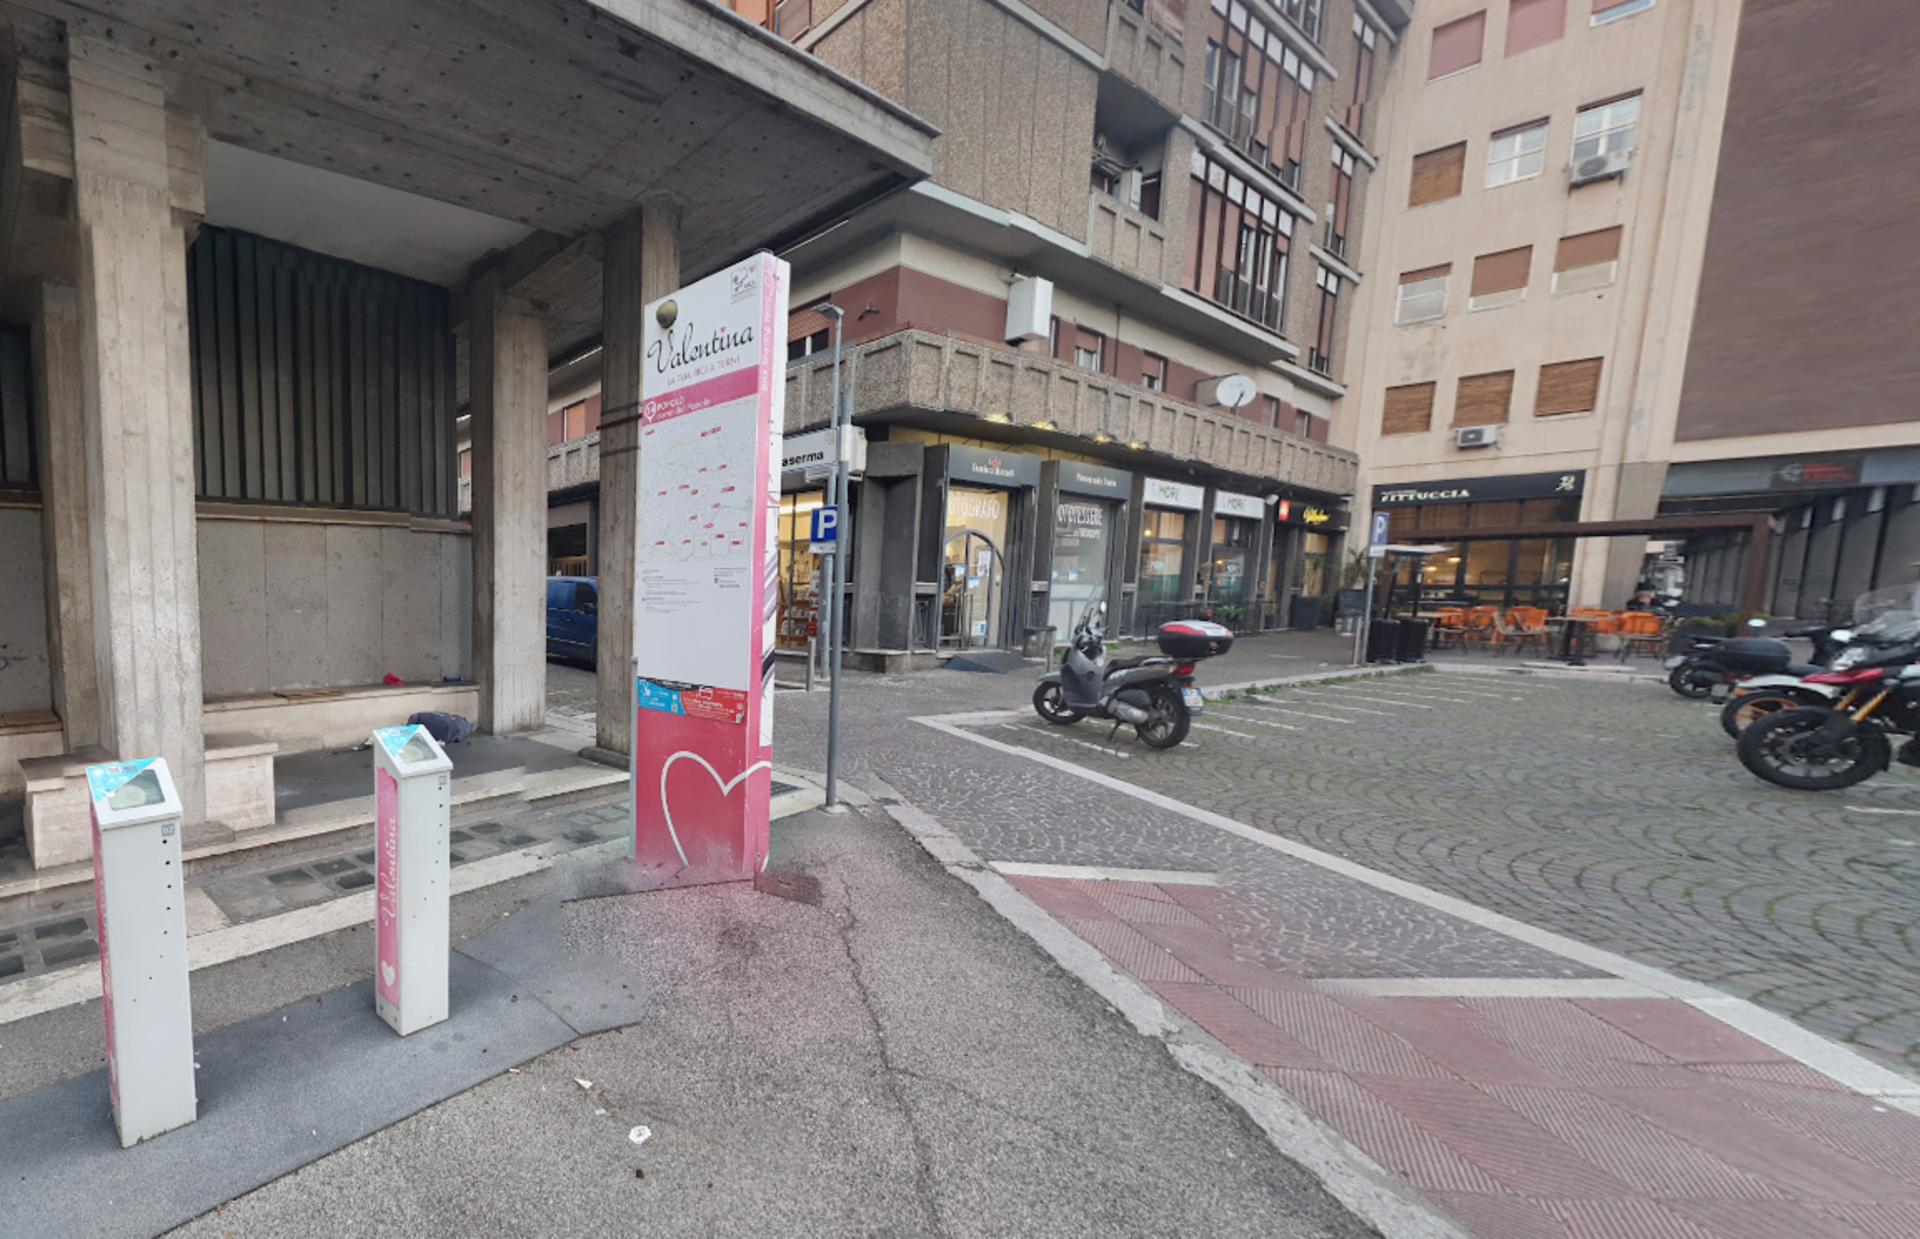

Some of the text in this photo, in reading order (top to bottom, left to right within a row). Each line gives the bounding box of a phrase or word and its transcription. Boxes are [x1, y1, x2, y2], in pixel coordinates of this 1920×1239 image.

[647, 322, 754, 374] Valentina
[782, 450, 824, 468] aserma
[817, 510, 837, 539] P
[1374, 516, 1386, 542] P
[379, 816, 397, 928] Valentina
